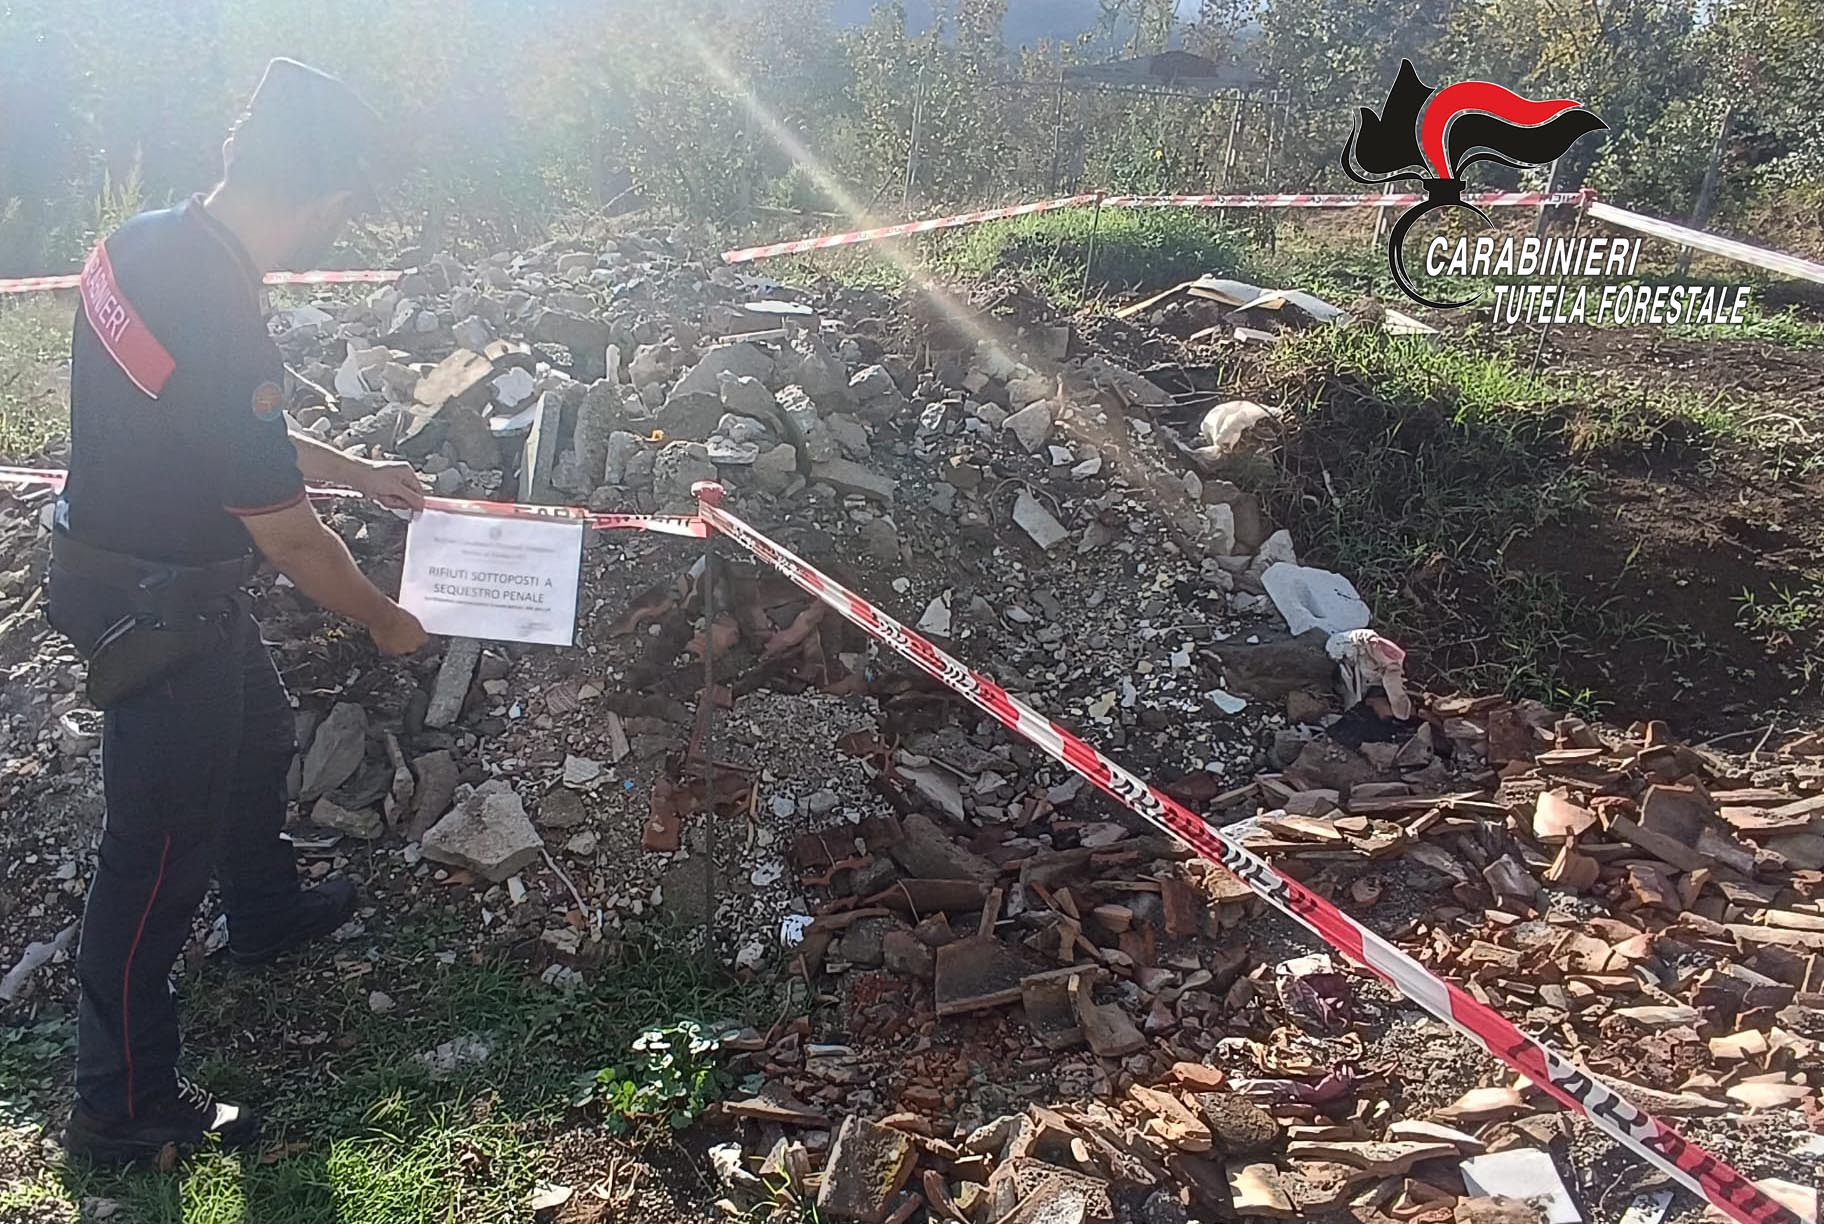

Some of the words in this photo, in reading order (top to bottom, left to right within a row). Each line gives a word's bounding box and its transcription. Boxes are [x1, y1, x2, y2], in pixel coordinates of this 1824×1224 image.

[428, 566, 468, 580] RIFIUTI
[472, 571, 539, 587] SOTTOPOSTI
[545, 577, 553, 588] A
[434, 583, 500, 600] SEQUESTRO
[503, 590, 545, 604] PENALE
